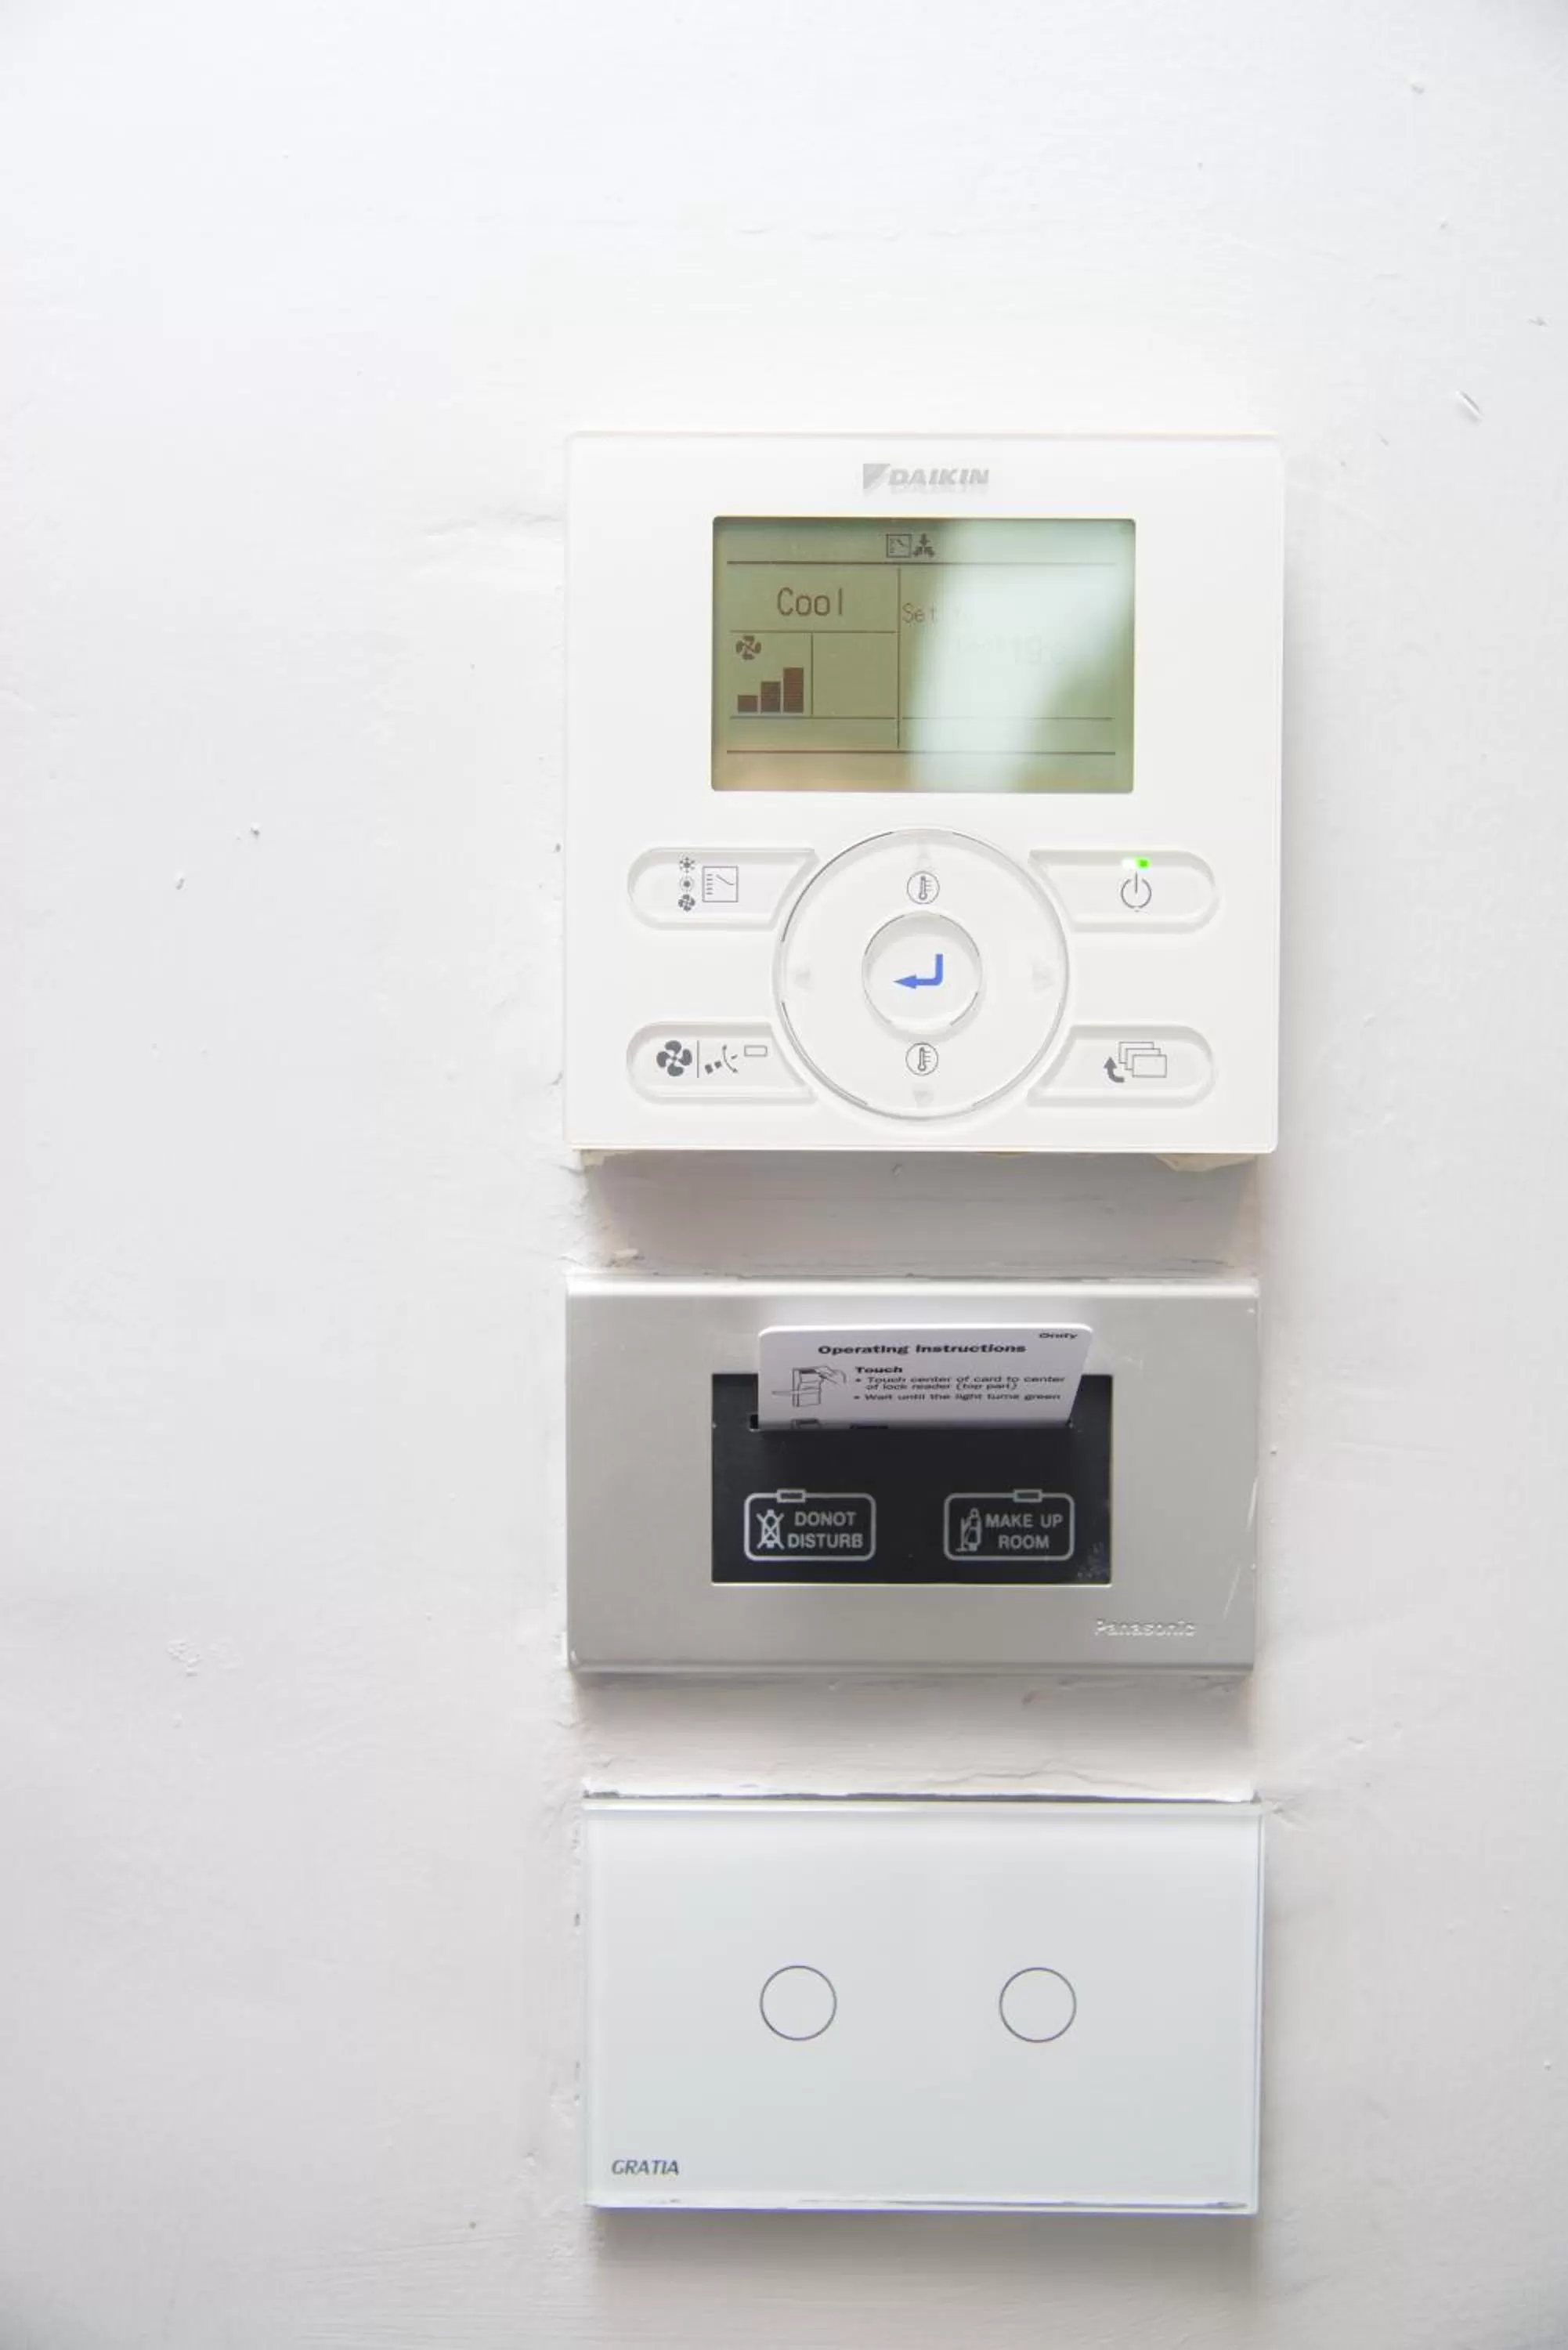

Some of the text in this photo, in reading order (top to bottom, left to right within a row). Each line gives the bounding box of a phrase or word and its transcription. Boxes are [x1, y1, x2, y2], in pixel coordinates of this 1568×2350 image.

[889, 468, 989, 486] DAIKIN
[776, 587, 843, 616] Cool
[818, 1344, 909, 1355] Operating
[794, 1511, 858, 1528] DONOT
[985, 1513, 1064, 1528] MAKE UP
[787, 1533, 864, 1549] DISTURB
[998, 1535, 1050, 1549] ROOM
[1095, 1619, 1196, 1637] Panasonic
[612, 2159, 679, 2176] GRATIA
